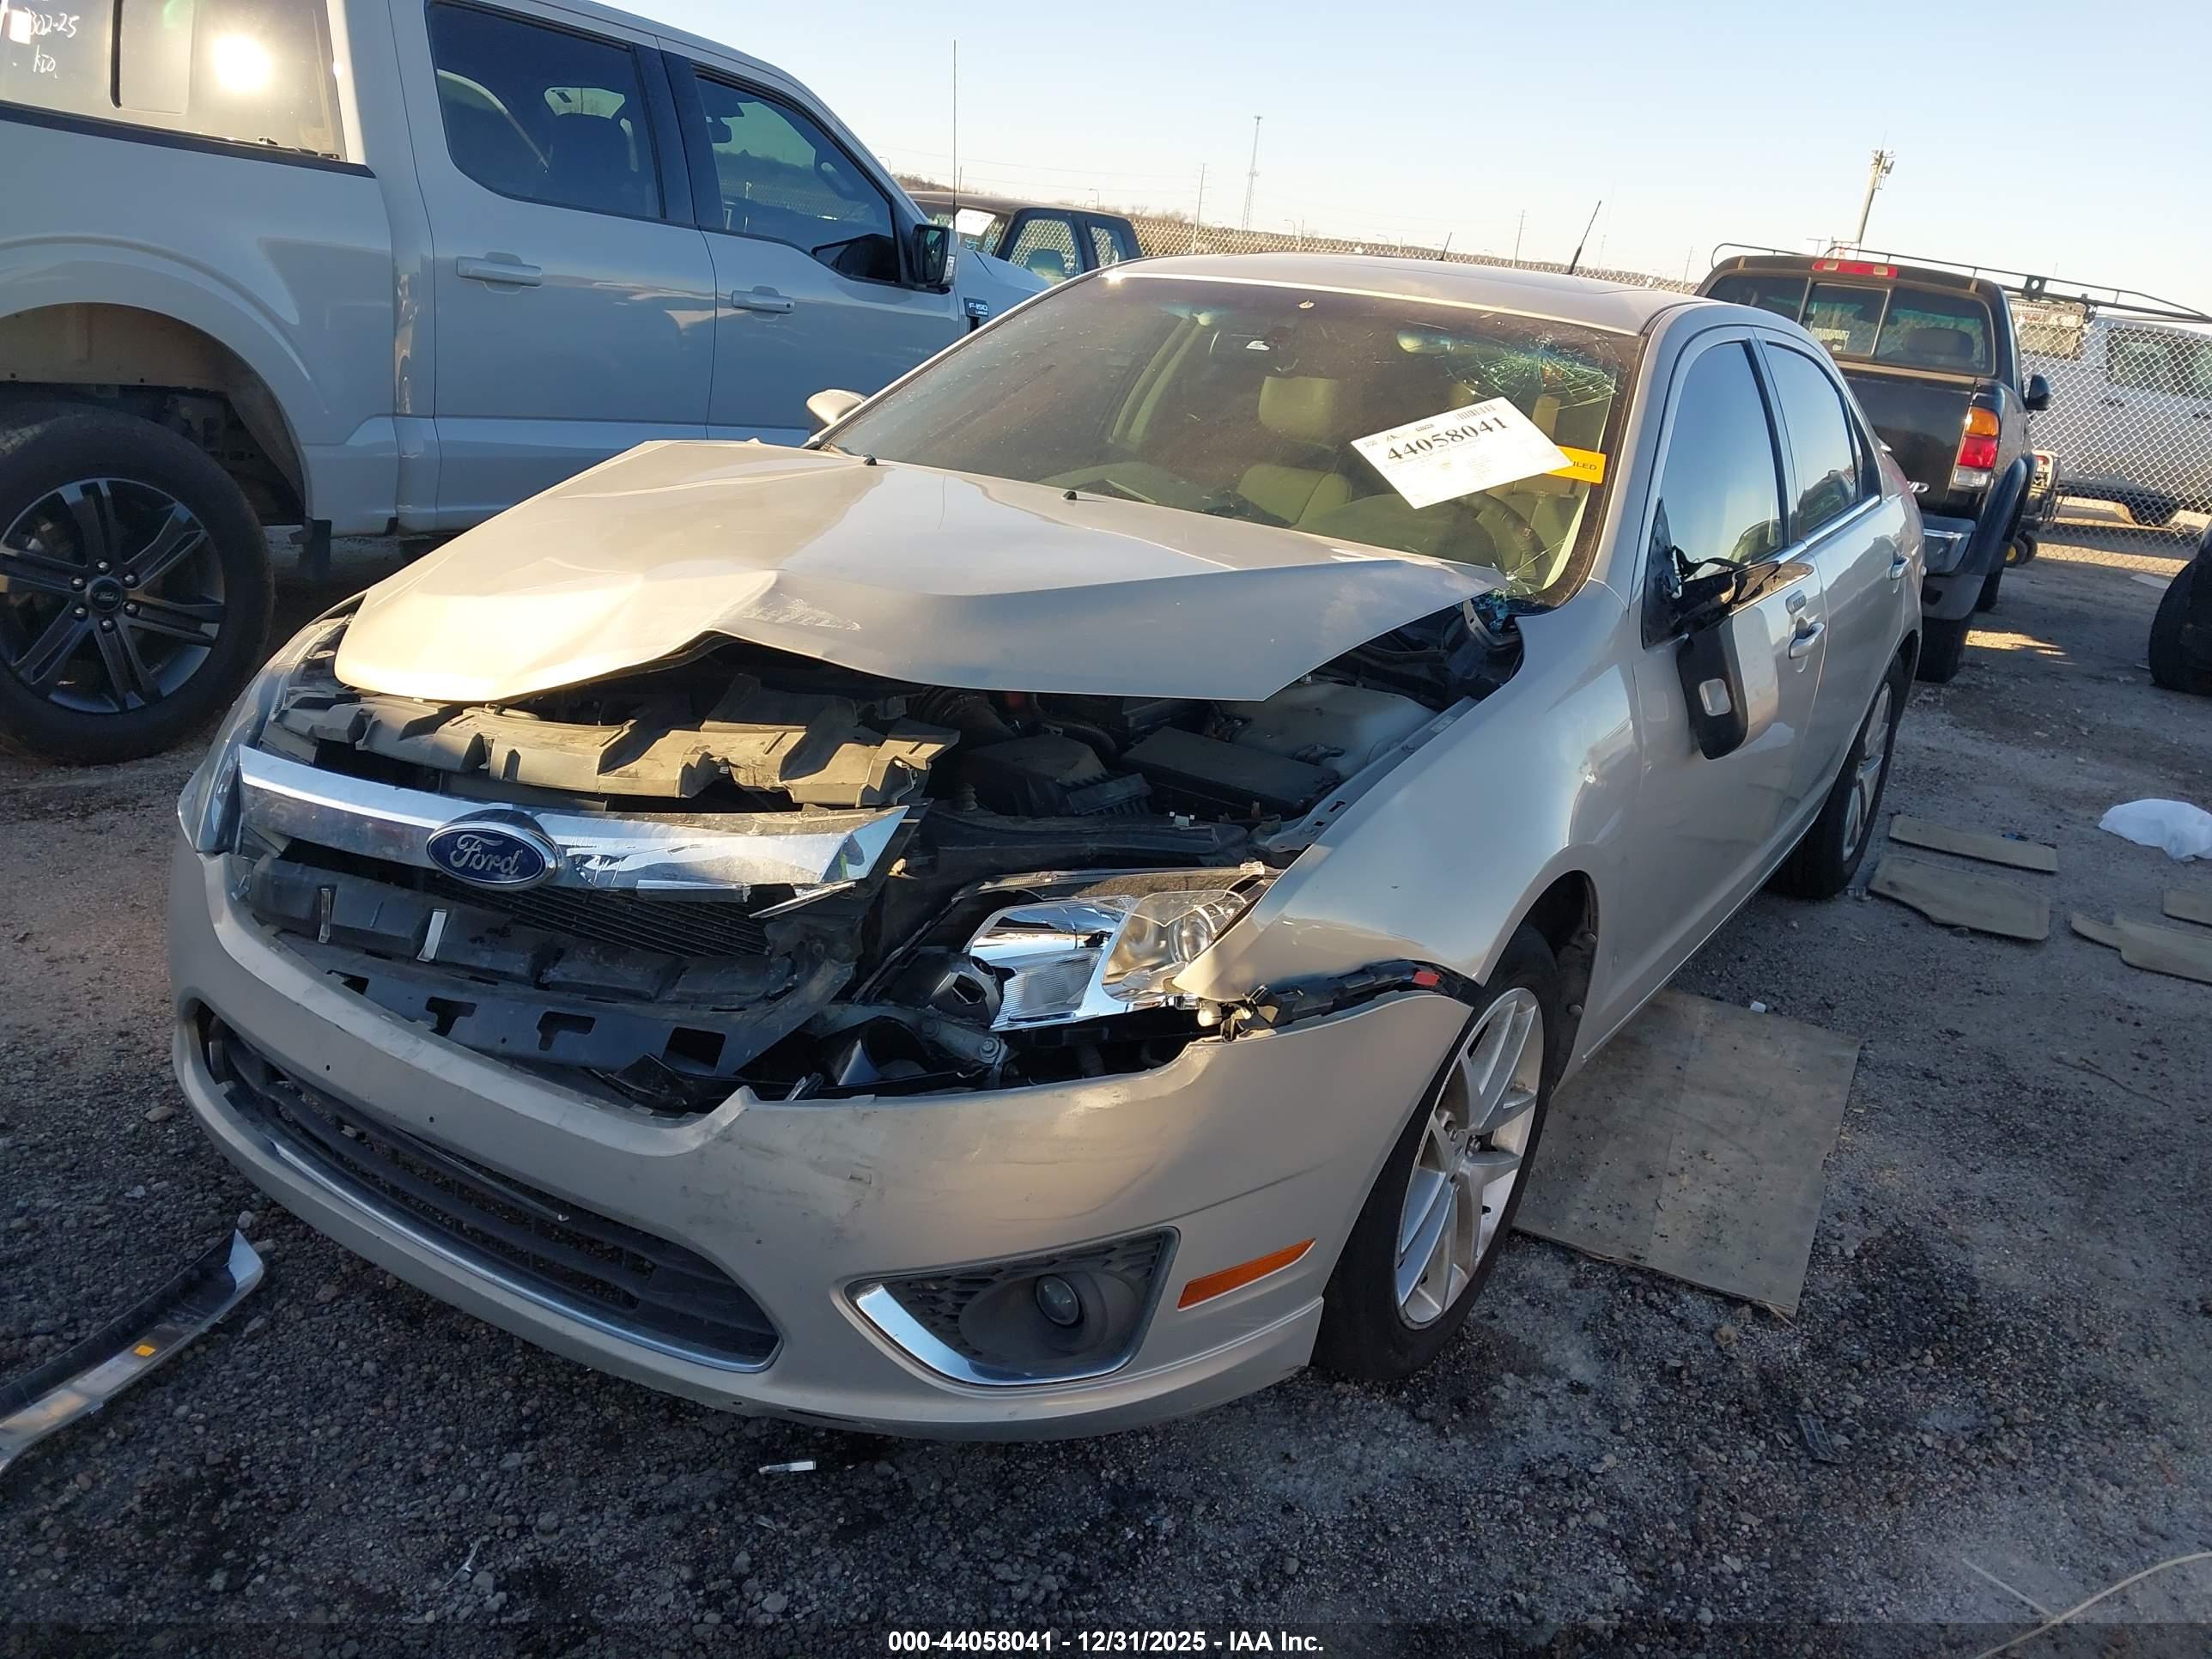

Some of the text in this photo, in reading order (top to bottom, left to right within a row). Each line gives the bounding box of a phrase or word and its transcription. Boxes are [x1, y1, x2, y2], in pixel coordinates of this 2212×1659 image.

[969, 302, 988, 311] F-150
[1388, 416, 1509, 459] 44058041
[449, 834, 523, 875] Ford
